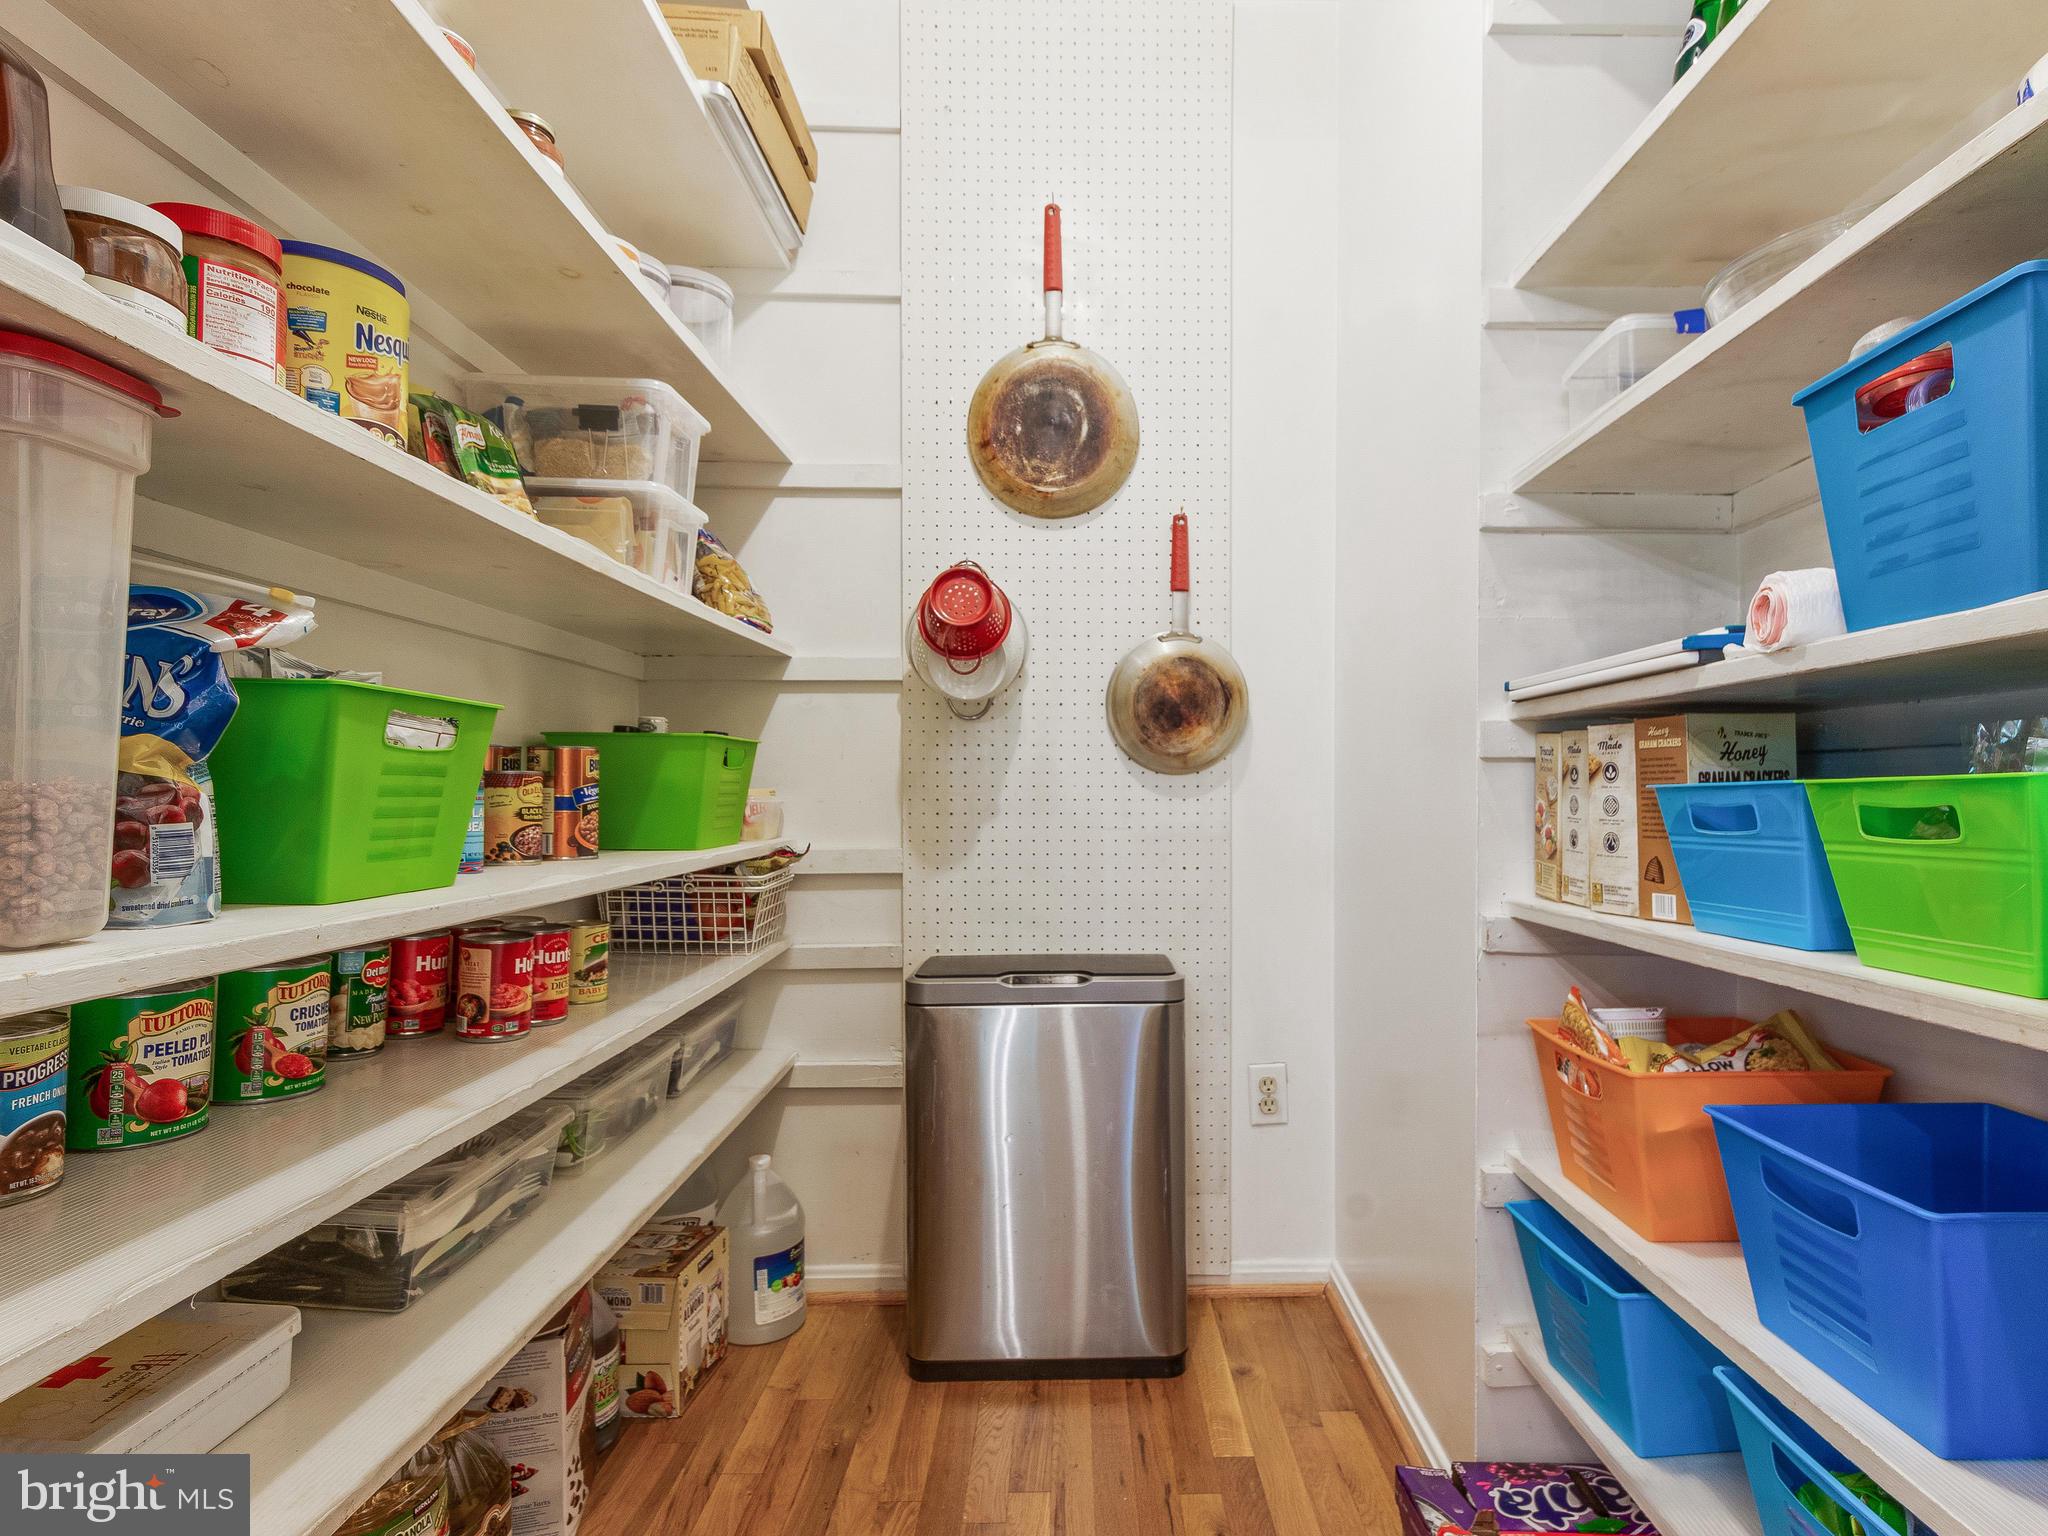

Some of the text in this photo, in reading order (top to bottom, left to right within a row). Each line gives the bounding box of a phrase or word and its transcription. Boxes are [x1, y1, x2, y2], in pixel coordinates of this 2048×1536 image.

[206, 265, 254, 284] Nutrition
[256, 279, 276, 296] Facts
[286, 281, 330, 296] chocolate
[206, 288, 246, 305] Calories
[260, 304, 276, 317] 190
[225, 612, 270, 627] POUNDS
[1647, 726, 1670, 738] Honey
[1734, 730, 1754, 738] TRADER
[1597, 740, 1623, 751] Made
[1638, 737, 1682, 749] GRAHAM CRACKERS
[1719, 740, 1769, 767] Honey
[1698, 769, 1791, 784] GRAHAM CRACKERS
[121, 898, 194, 912] sweetened dried cranberries
[366, 968, 379, 978] Del
[352, 988, 374, 996] MADE
[578, 986, 601, 996] BABY
[352, 1015, 371, 1026] NEW
[253, 1032, 263, 1040] 15
[9, 1041, 52, 1056] VEGETABLE
[143, 1036, 197, 1059] PEELED
[171, 1046, 211, 1067] TOMATOES
[112, 1070, 124, 1079] 25
[11, 1089, 50, 1110] FRENCH
[1489, 1476, 1652, 1530] anta
